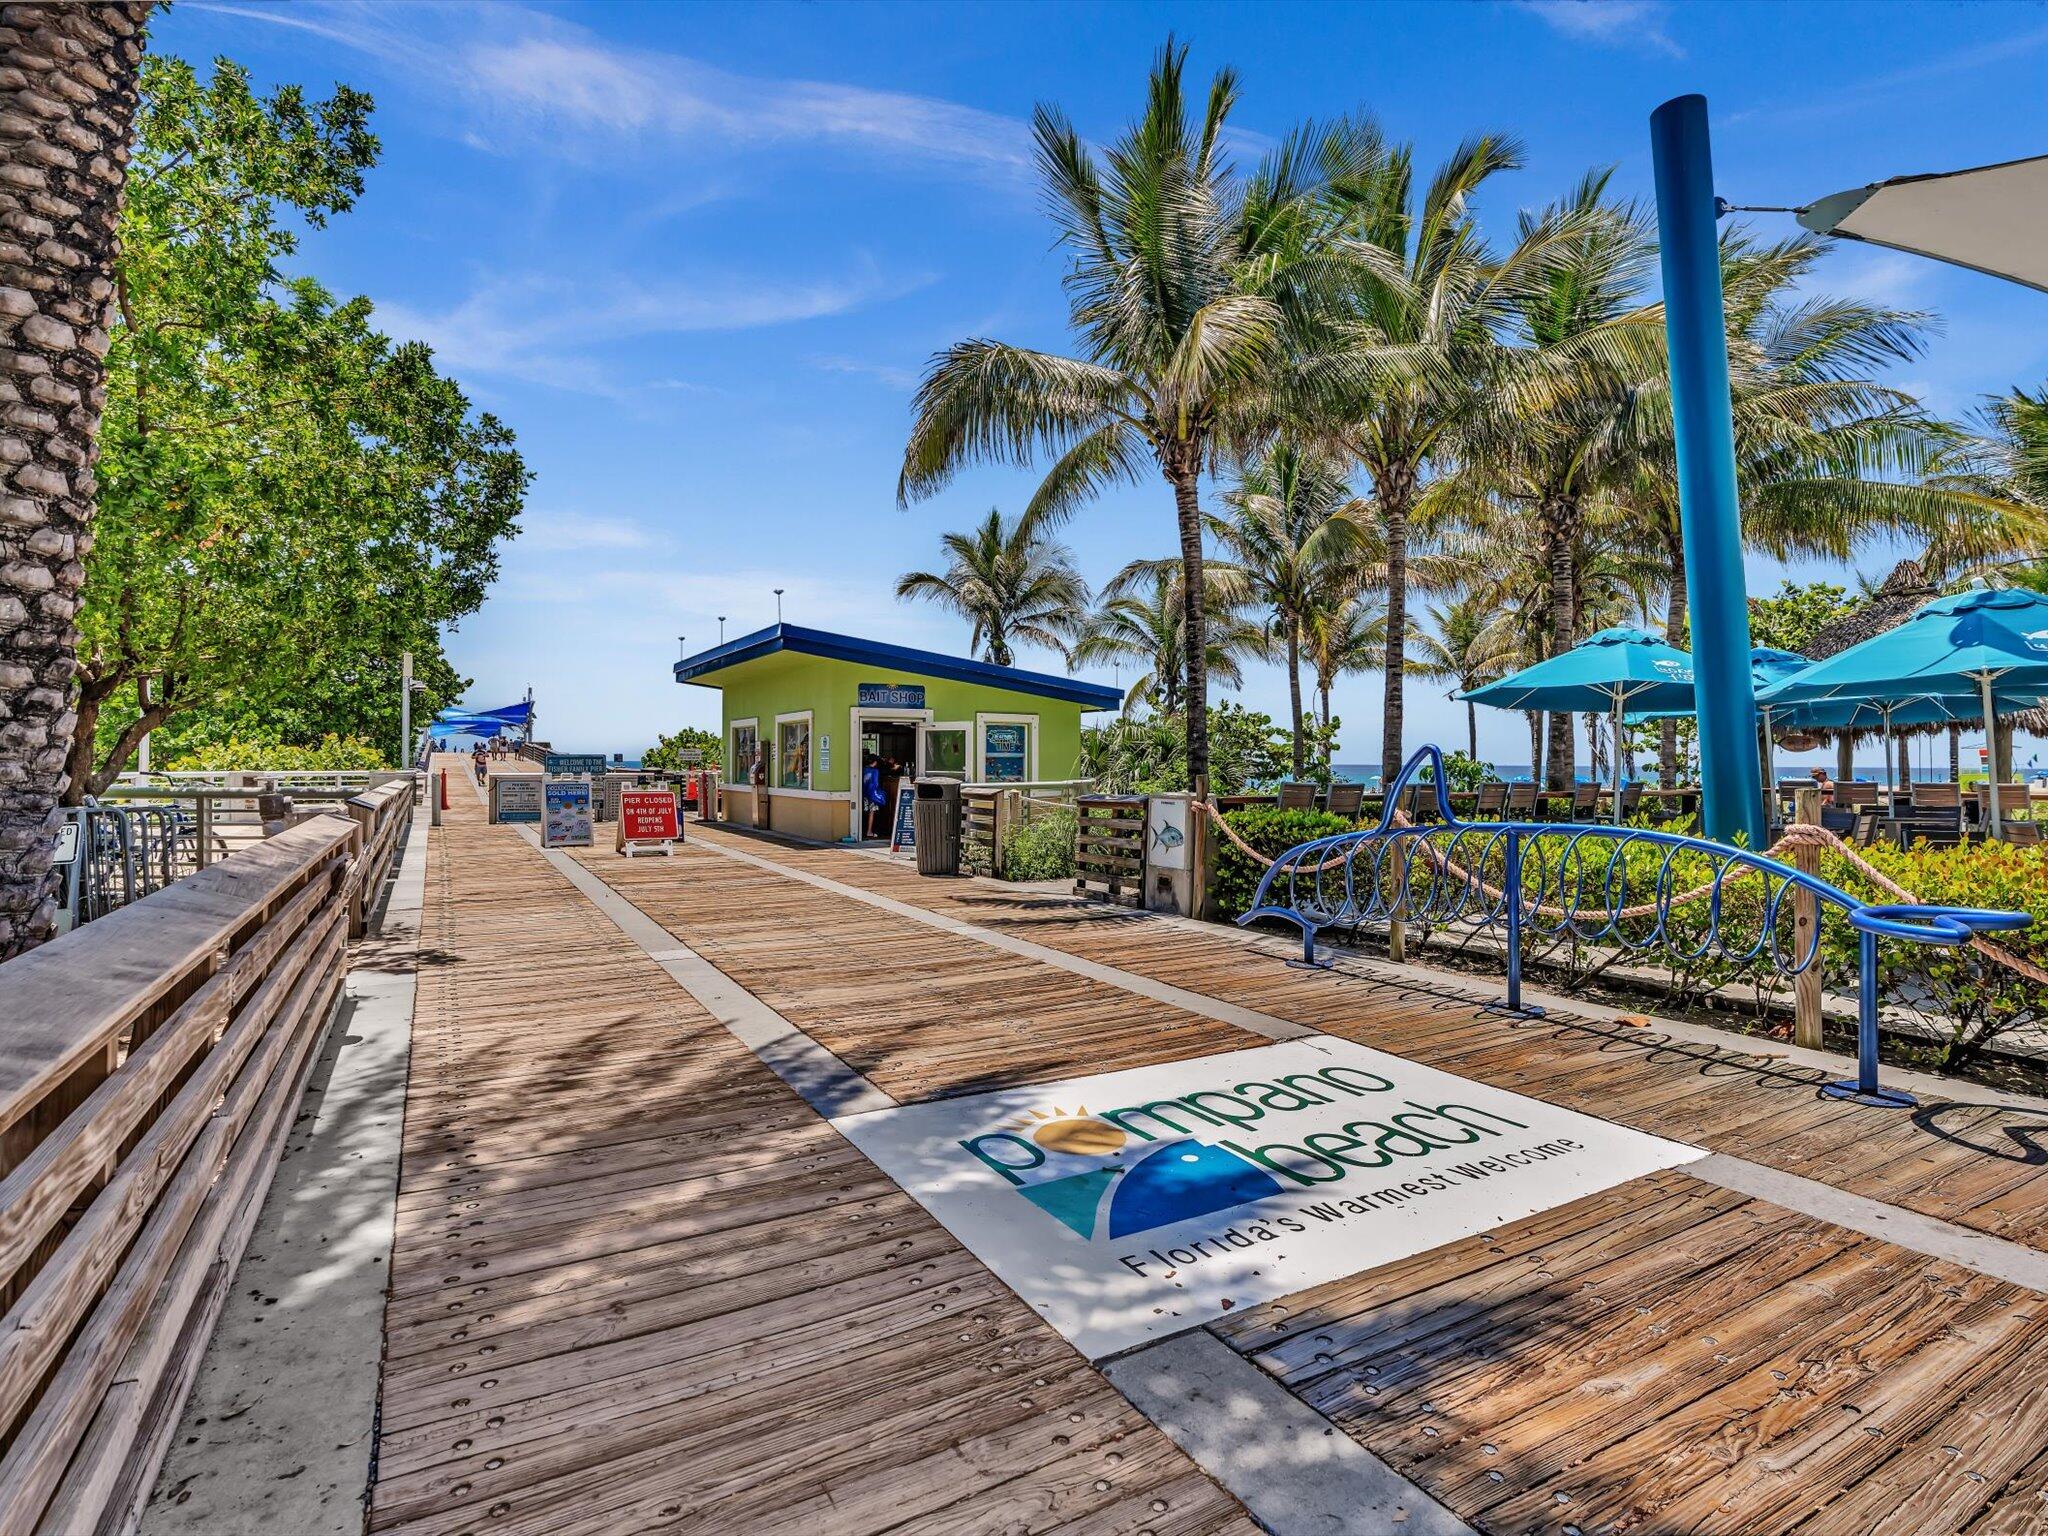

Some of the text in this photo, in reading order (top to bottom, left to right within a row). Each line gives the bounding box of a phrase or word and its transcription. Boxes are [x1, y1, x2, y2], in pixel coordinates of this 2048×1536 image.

[859, 689, 925, 704] BAIT SHOP
[559, 758, 603, 766] WELCOME TO THE
[657, 807, 672, 815] JULY
[637, 816, 663, 824] REOPENS
[637, 825, 665, 833] JULY 5TH
[1219, 1100, 1530, 1187] beach
[1118, 1136, 1585, 1278] Florida's Warmest Welcome
